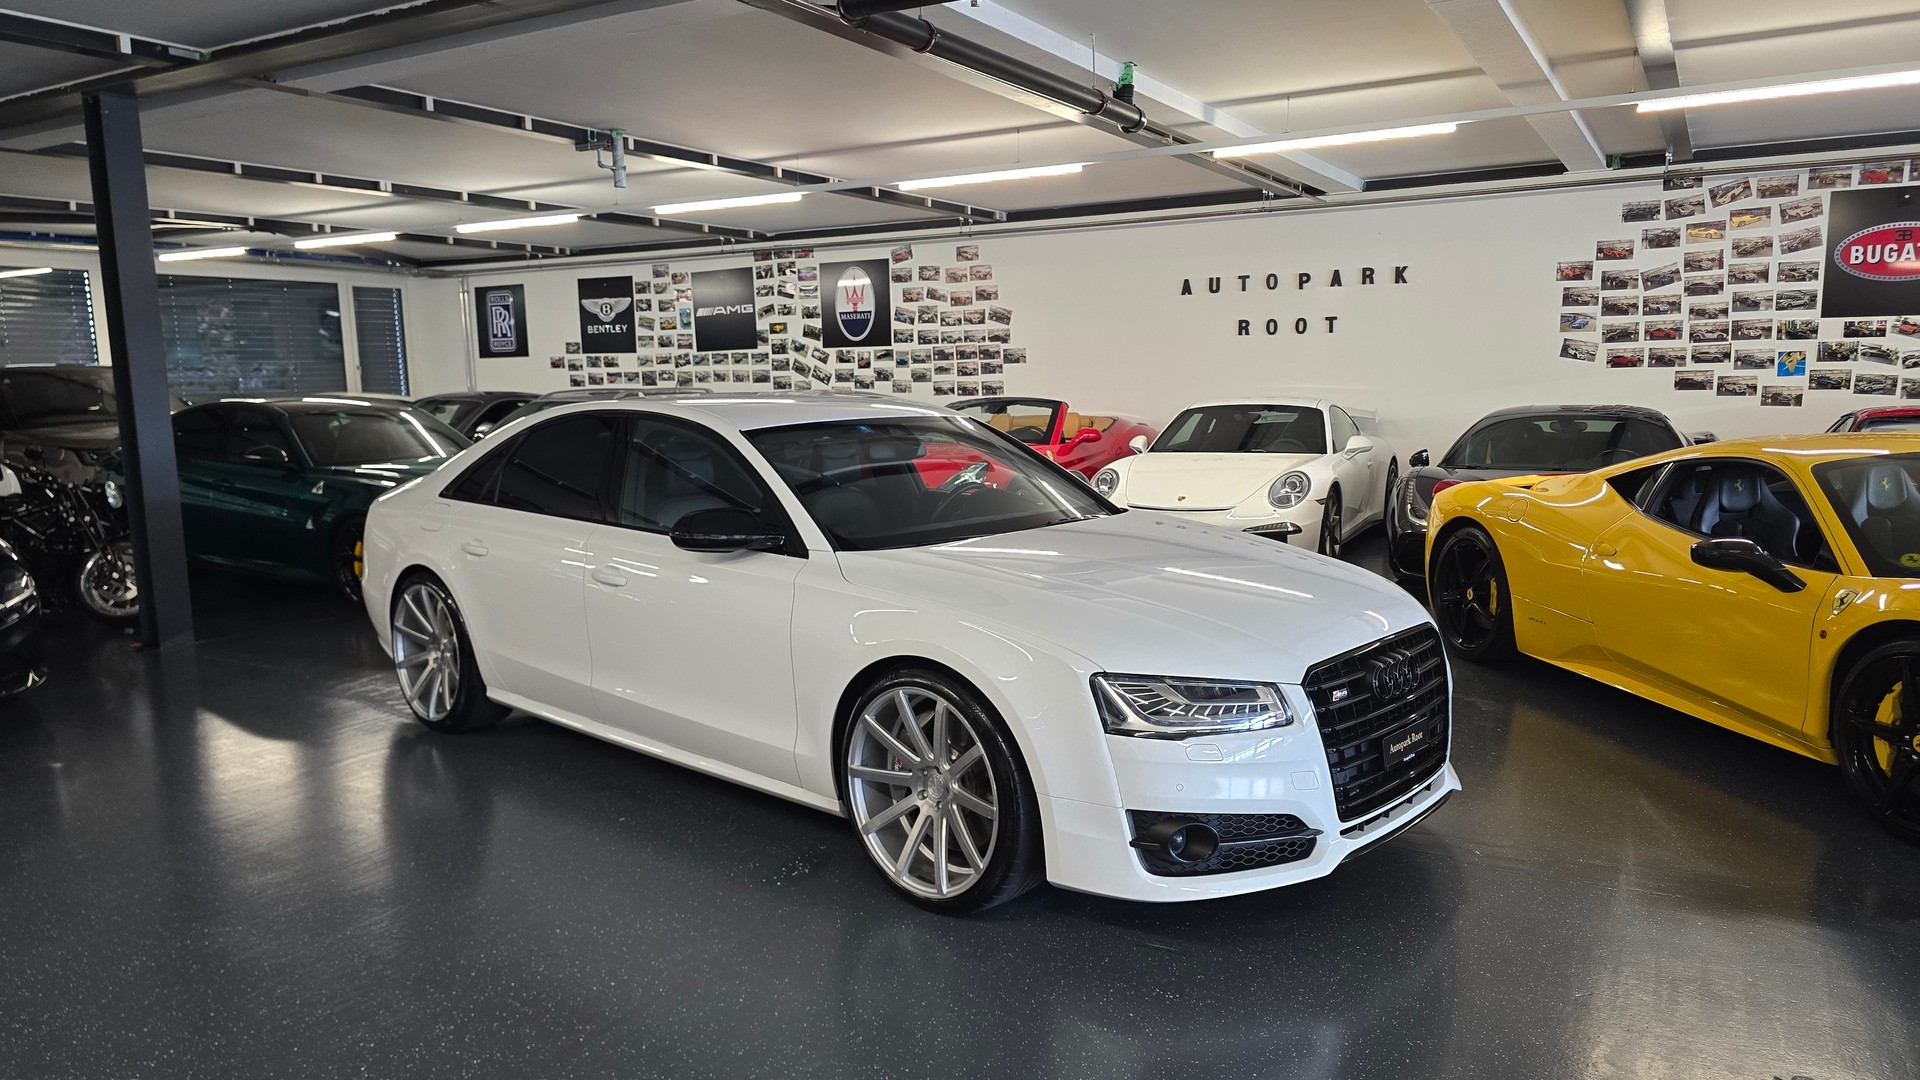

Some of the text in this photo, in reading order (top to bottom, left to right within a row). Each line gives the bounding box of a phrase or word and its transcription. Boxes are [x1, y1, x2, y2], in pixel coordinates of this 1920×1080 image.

[1850, 242, 1920, 264] BUGA
[1180, 266, 1409, 296] AUTOPARK
[713, 304, 754, 316] AMG
[840, 312, 871, 320] MASERATI
[587, 324, 628, 334] BENTLEY
[1237, 316, 1338, 336] ROOT
